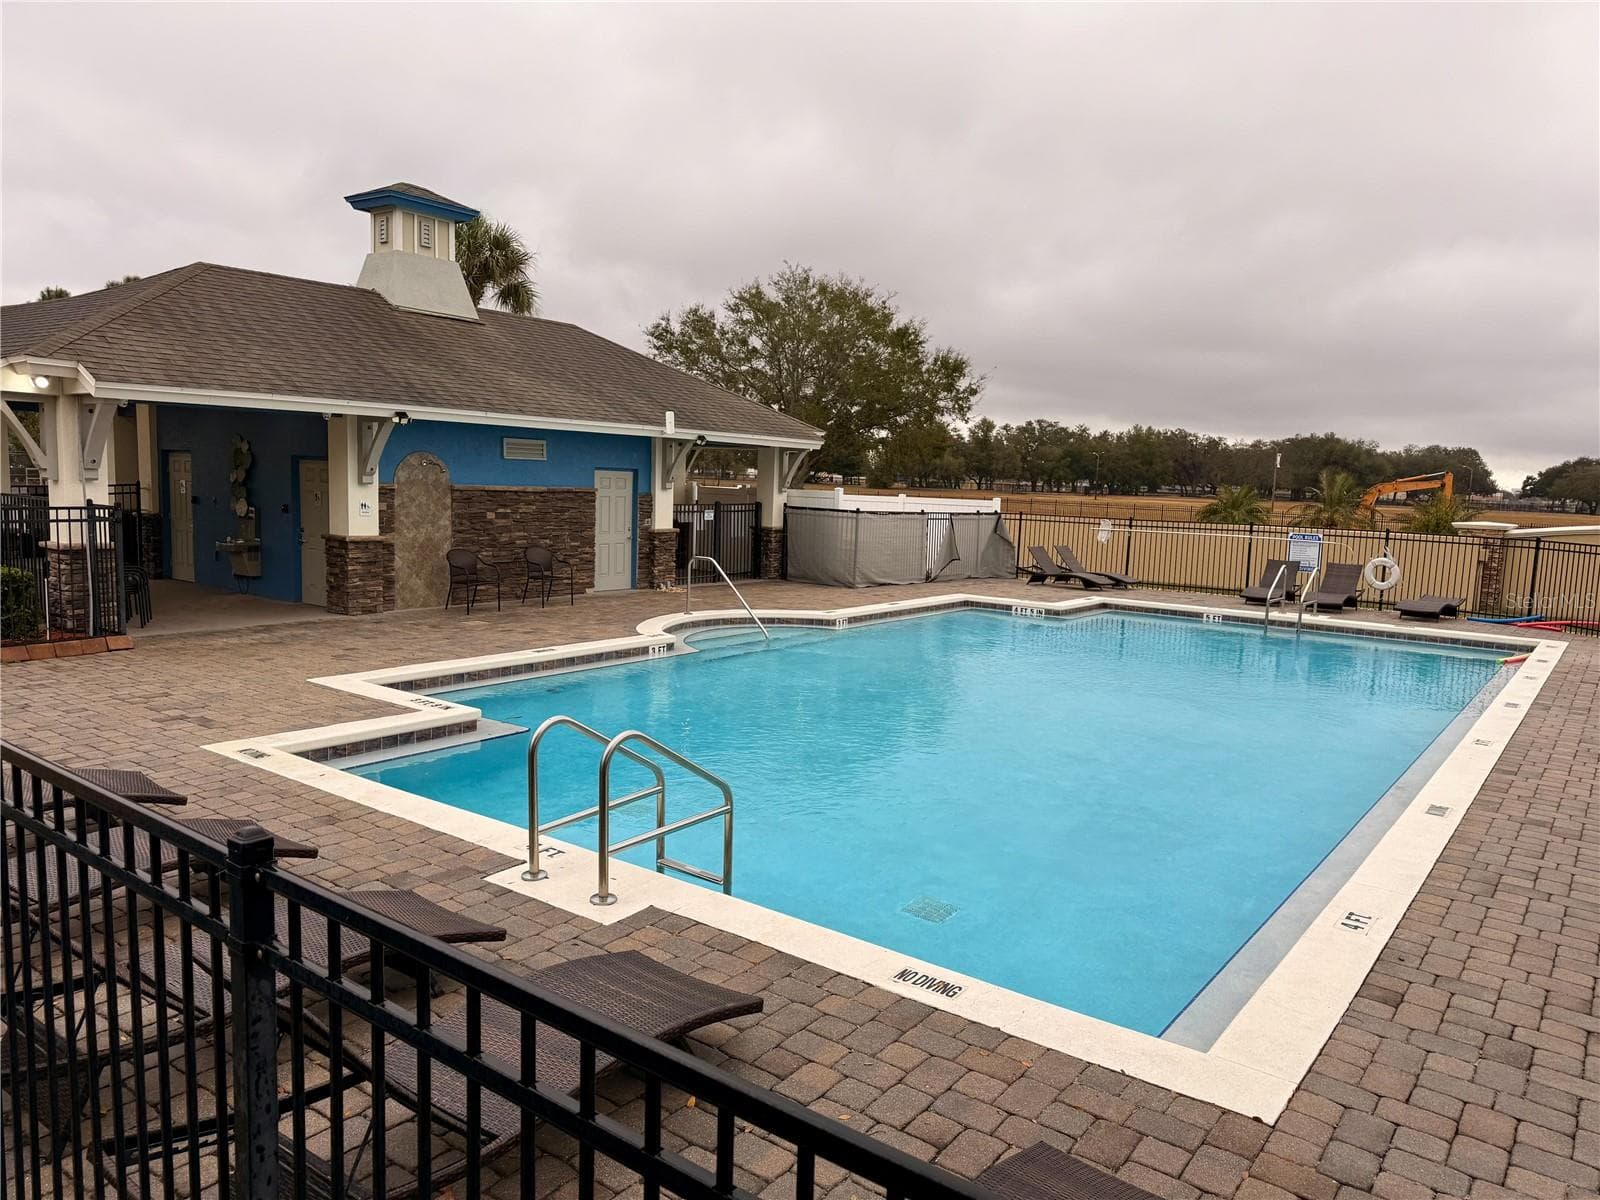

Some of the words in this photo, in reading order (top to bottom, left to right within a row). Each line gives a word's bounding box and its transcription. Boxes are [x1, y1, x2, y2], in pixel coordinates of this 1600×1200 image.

[1345, 911, 1372, 925] FT
[1341, 922, 1365, 930] 4
[893, 970, 918, 982] NO
[911, 974, 962, 998] DIVING
